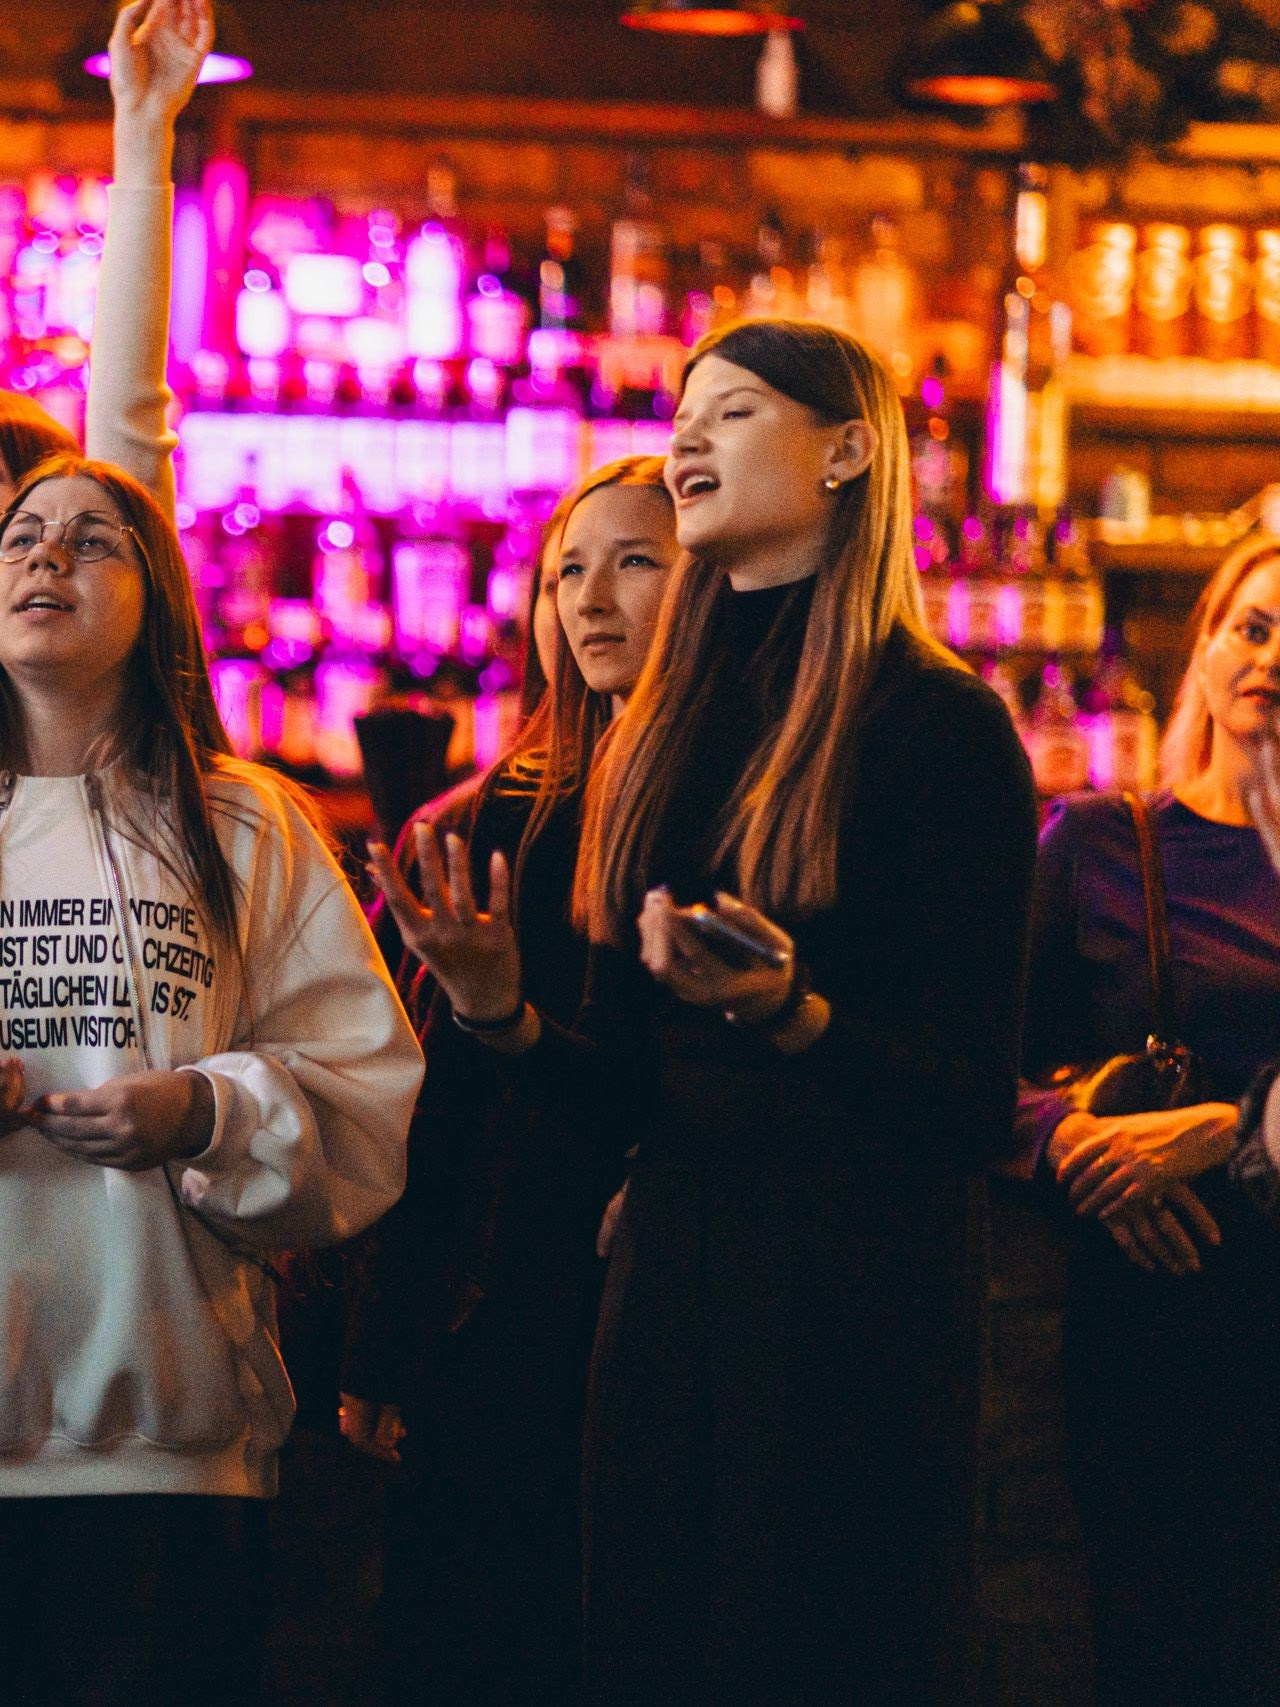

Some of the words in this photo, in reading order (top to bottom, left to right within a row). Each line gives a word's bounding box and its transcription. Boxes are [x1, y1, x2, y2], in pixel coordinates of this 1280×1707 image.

[20, 898, 85, 928] IMMER
[32, 934, 62, 967] IST
[65, 934, 108, 965] UND
[0, 970, 109, 1010] TÄGLICHEN
